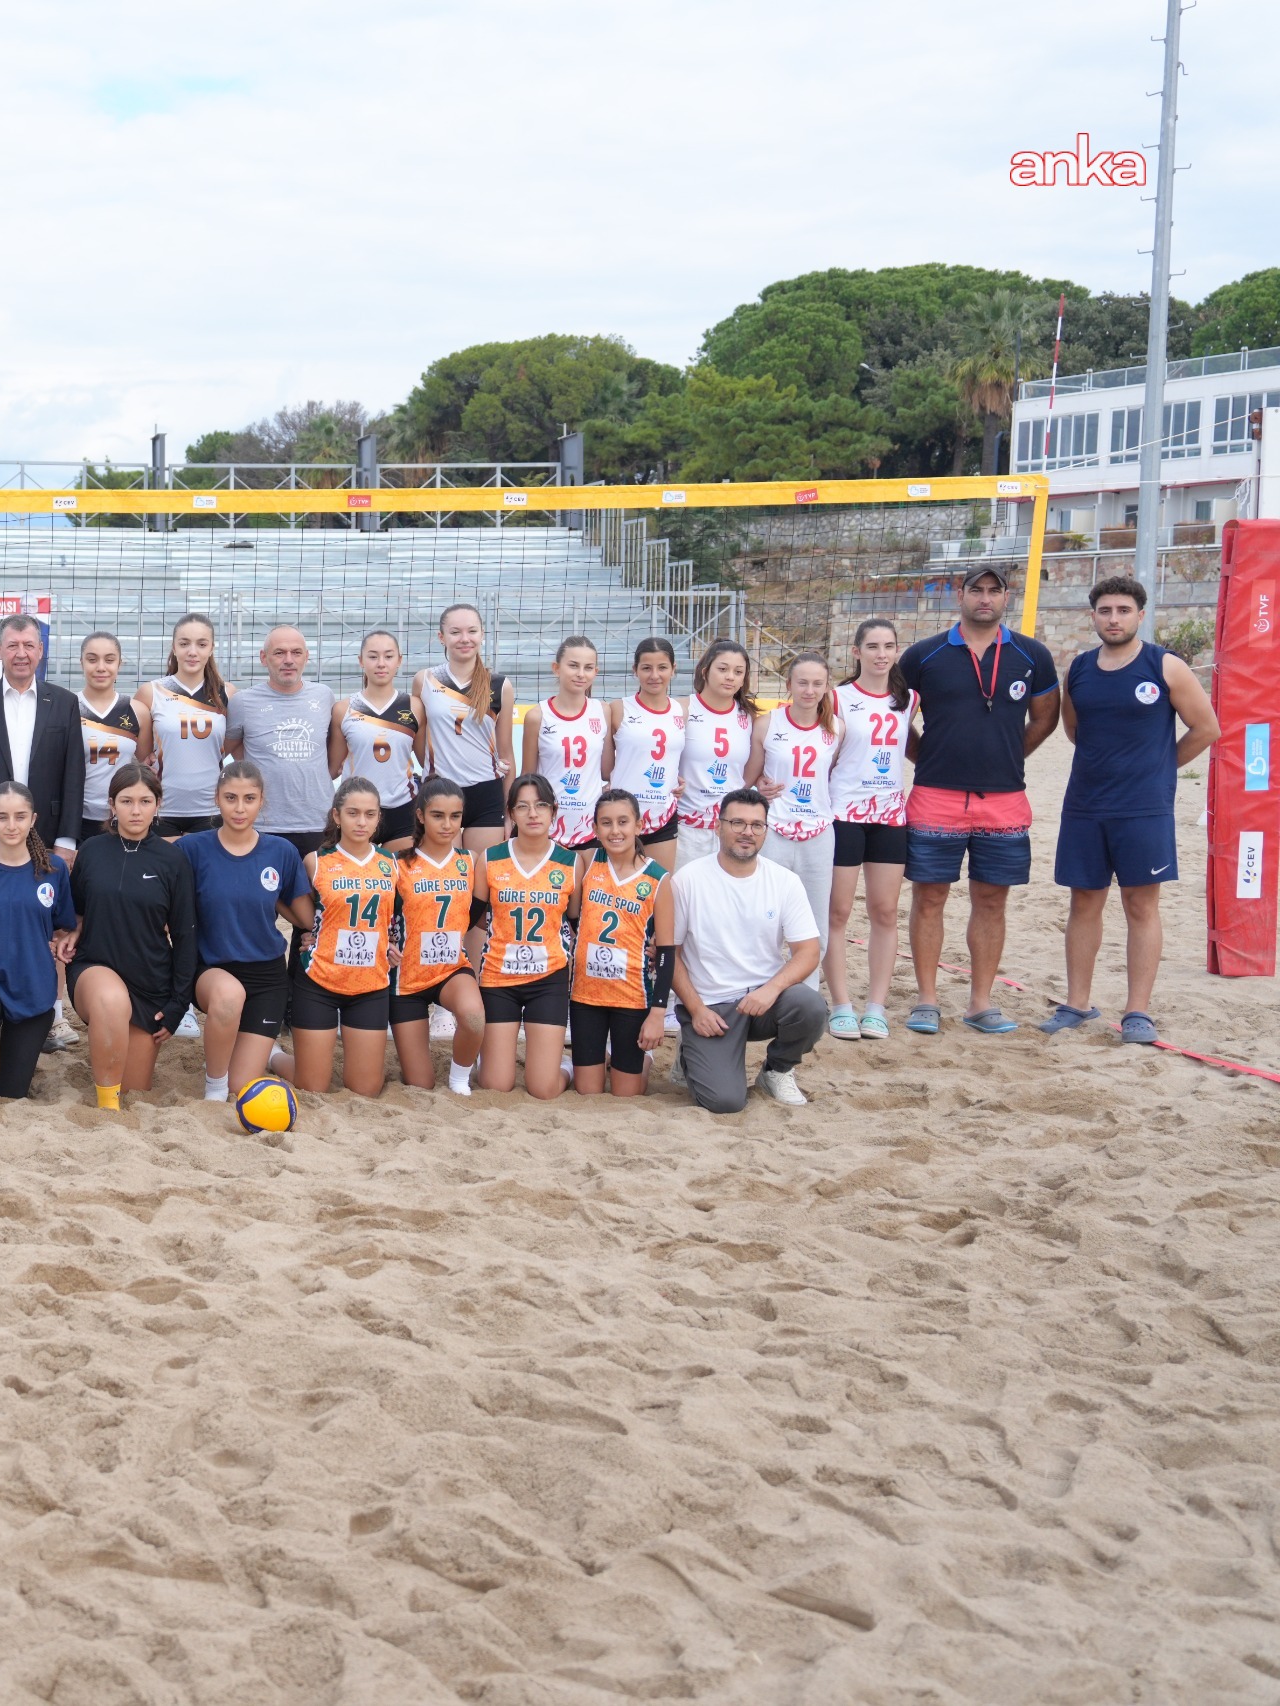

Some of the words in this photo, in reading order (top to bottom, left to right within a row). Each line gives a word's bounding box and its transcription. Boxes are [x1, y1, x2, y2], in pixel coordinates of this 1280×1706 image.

[1259, 594, 1269, 617] TVF
[179, 711, 213, 739] 10
[450, 705, 469, 735] 7
[869, 712, 899, 746] 22
[88, 736, 120, 765] 14
[373, 731, 391, 763] 6
[561, 735, 587, 768] 13
[650, 728, 667, 760] 3
[714, 727, 729, 758] 5
[715, 763, 728, 776] HB
[792, 745, 818, 778] 12
[880, 751, 891, 765] HB
[568, 773, 581, 786] HB
[652, 766, 666, 780] HB
[798, 783, 812, 797] HB
[1246, 846, 1255, 867] CEV
[332, 877, 362, 890] GÜRE
[365, 879, 393, 891] SPOR
[414, 879, 441, 894] GÜRE
[443, 879, 468, 891] SPOR
[498, 888, 526, 902] GÜRE
[529, 891, 559, 905] SPOR
[345, 893, 380, 928] 14
[435, 894, 453, 929] 7
[588, 889, 613, 906] GÜRE
[615, 893, 641, 915] SPOR
[509, 906, 546, 943] 12
[598, 910, 620, 945] 2
[336, 948, 374, 962] GÜMÜŞ
[420, 948, 457, 961] GÜMÜŞ
